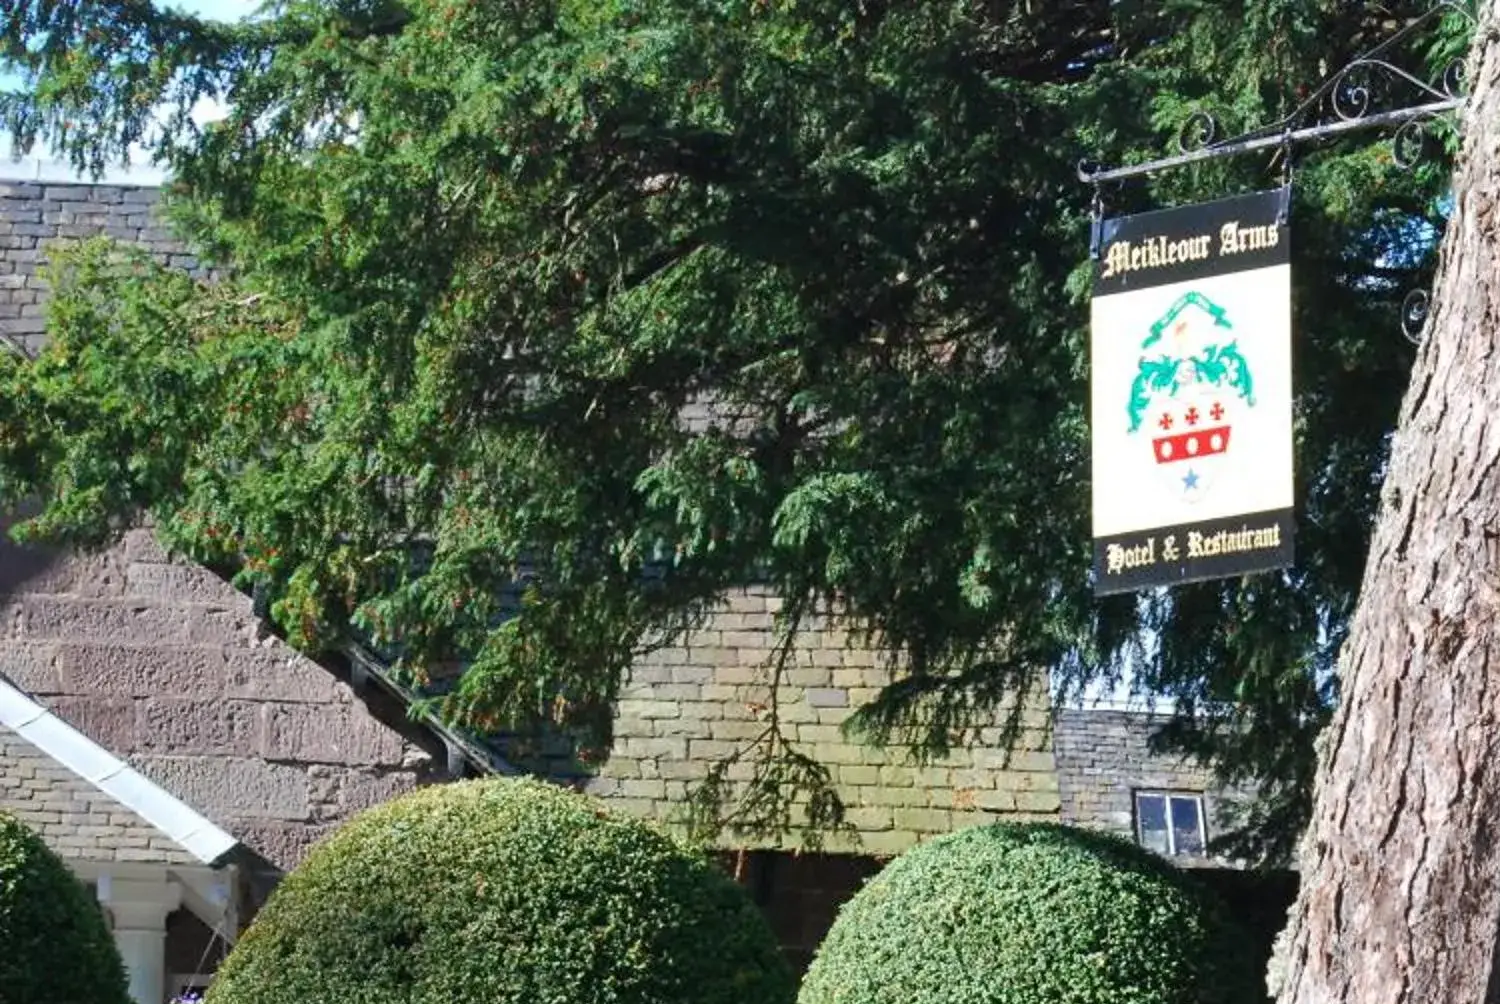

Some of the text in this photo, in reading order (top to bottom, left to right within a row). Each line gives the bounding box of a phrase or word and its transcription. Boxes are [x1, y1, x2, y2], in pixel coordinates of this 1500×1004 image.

[1101, 221, 1279, 279] Meikleour Arms
[1106, 522, 1280, 574] Hotel & Restaurant
